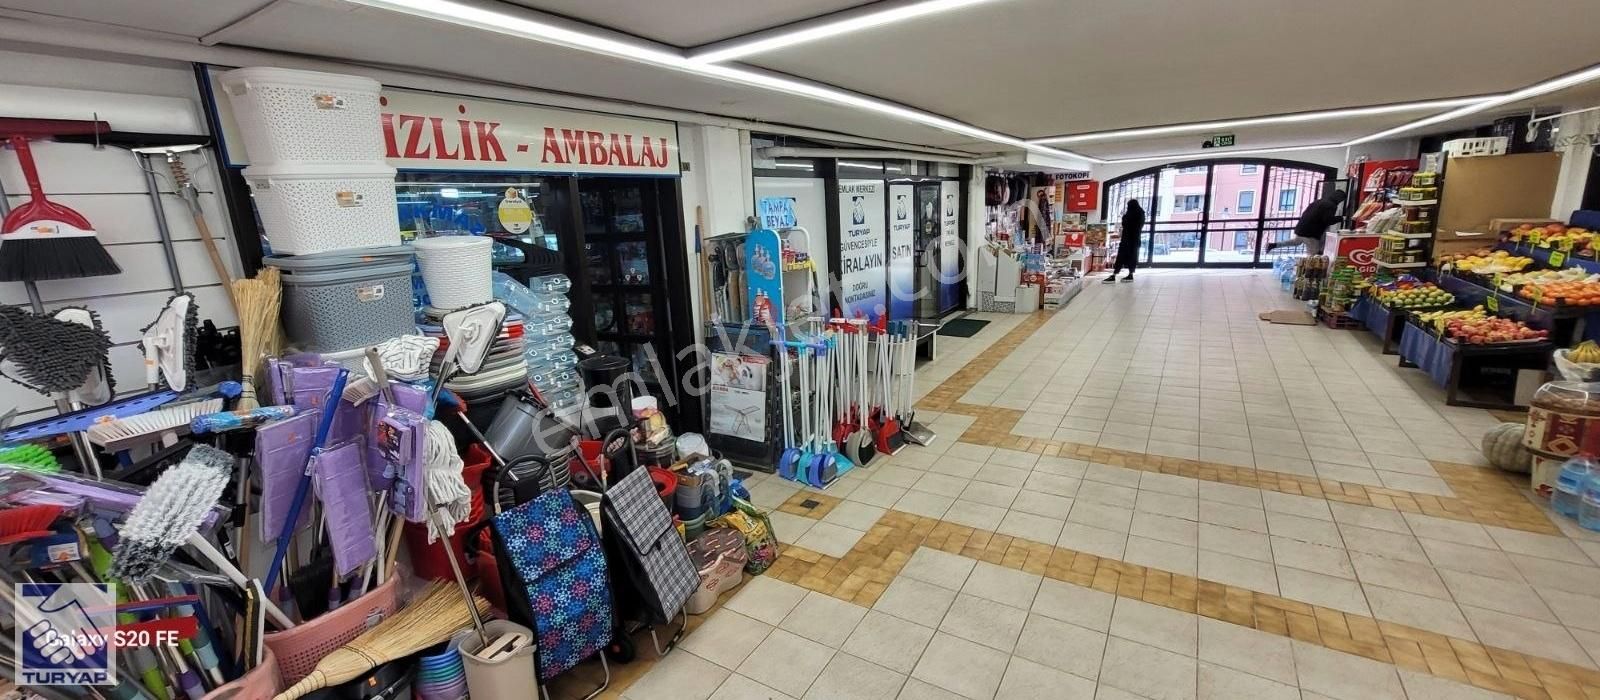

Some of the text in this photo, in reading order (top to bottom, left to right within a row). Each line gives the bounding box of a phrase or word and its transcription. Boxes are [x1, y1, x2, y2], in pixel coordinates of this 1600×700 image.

[380, 95, 507, 162] İZLİK
[542, 127, 668, 169] AMBALAJ
[848, 228, 870, 238] TURYAP
[892, 243, 912, 259] SATIN
